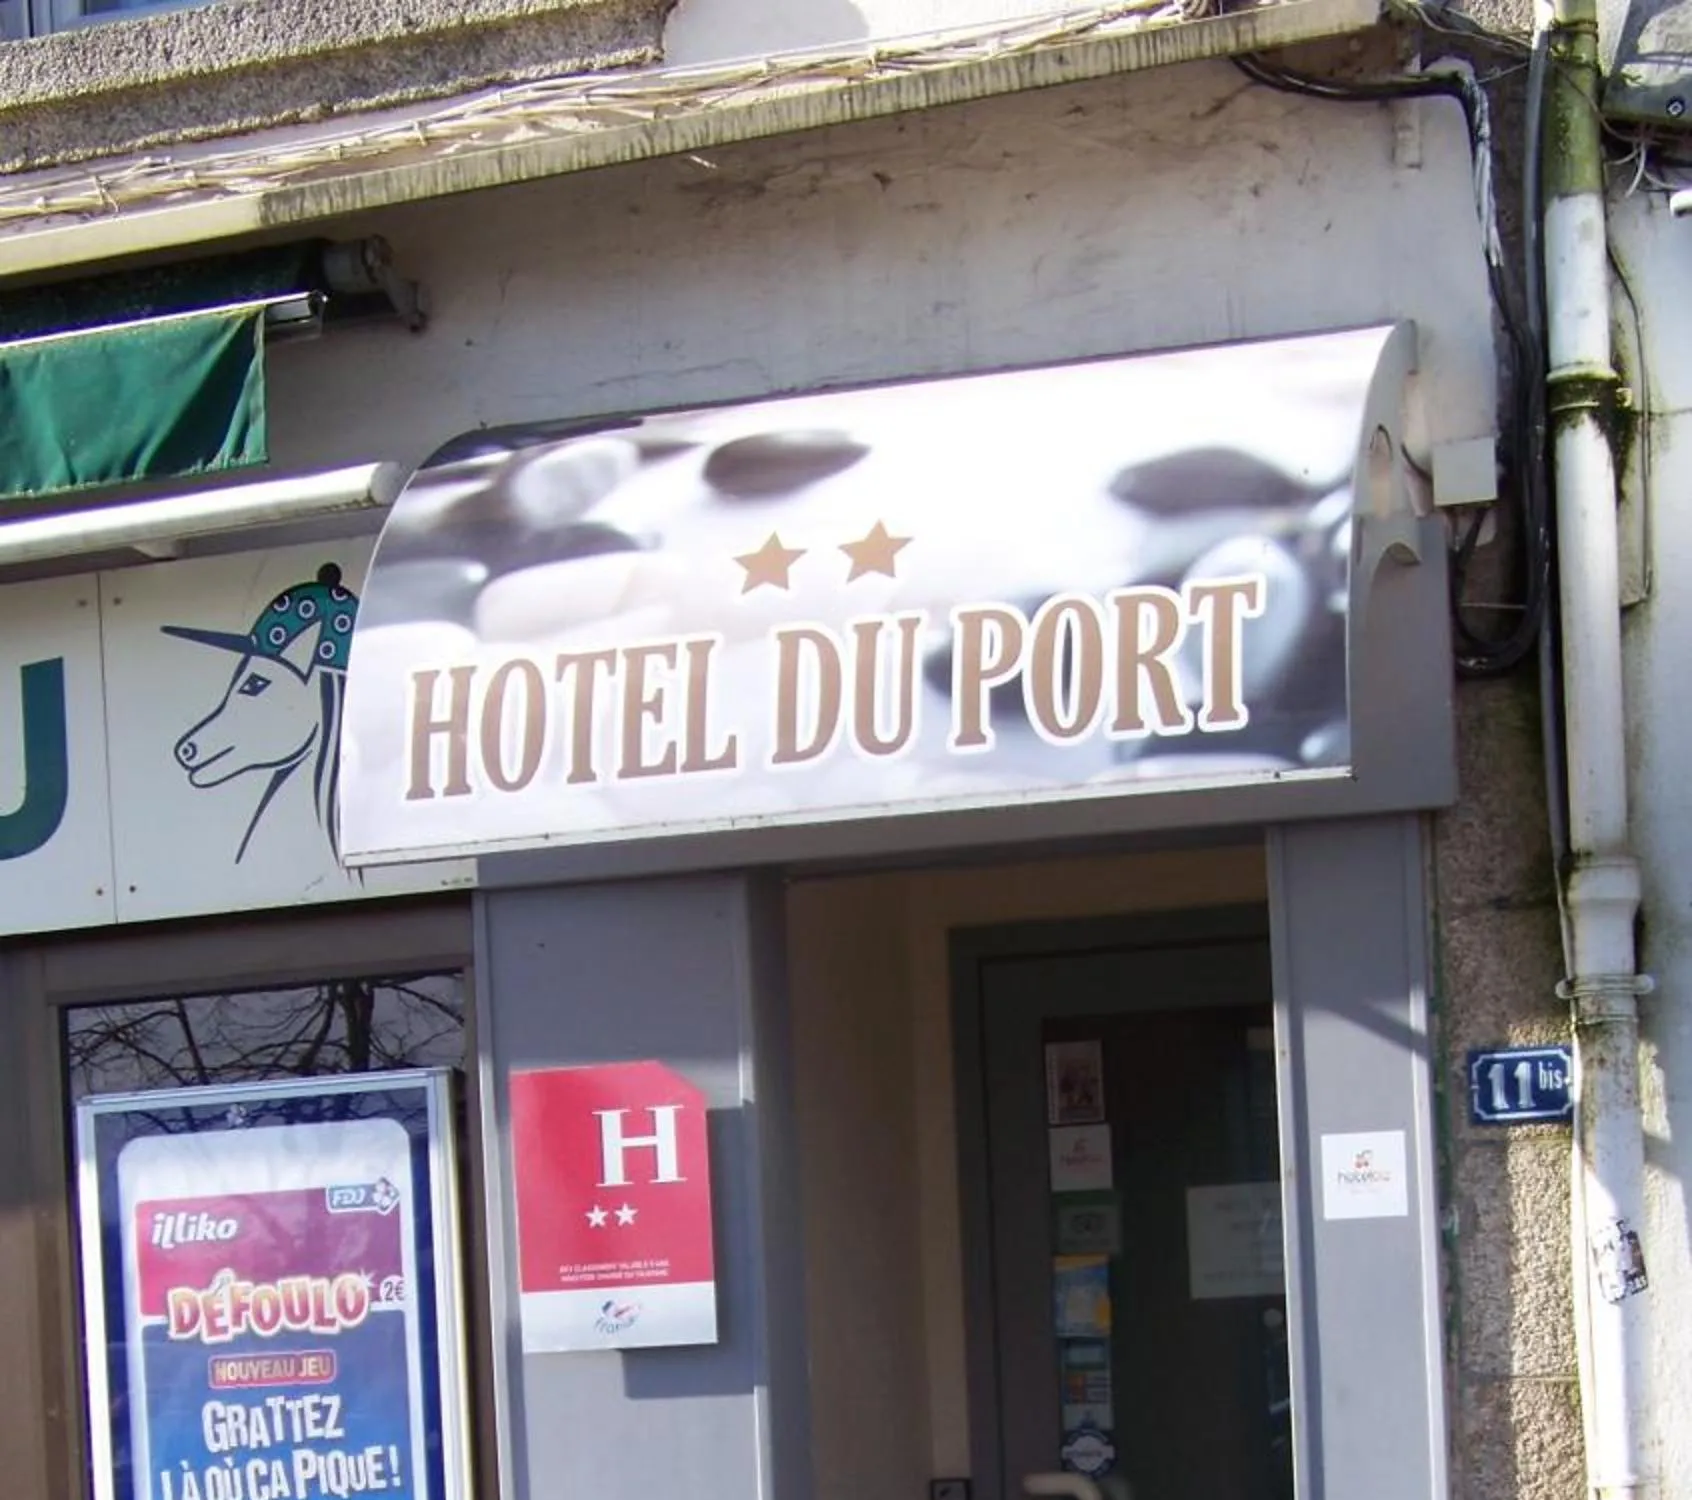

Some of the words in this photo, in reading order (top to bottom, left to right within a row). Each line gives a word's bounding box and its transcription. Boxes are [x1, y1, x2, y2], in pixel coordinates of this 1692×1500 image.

[405, 639, 737, 800] HOTEL
[772, 617, 920, 764] DU
[955, 582, 1258, 747] PORT
[1488, 1061, 1536, 1110] 11
[1539, 1061, 1562, 1091] bis
[592, 1104, 687, 1186] H
[332, 1188, 366, 1207] FDJ
[151, 1211, 238, 1249] illiko
[168, 1267, 369, 1344] DÉFOULO
[214, 1358, 296, 1382] NOUVEAU
[298, 1355, 331, 1377] JEU
[202, 1394, 345, 1453] GRATTEZ
